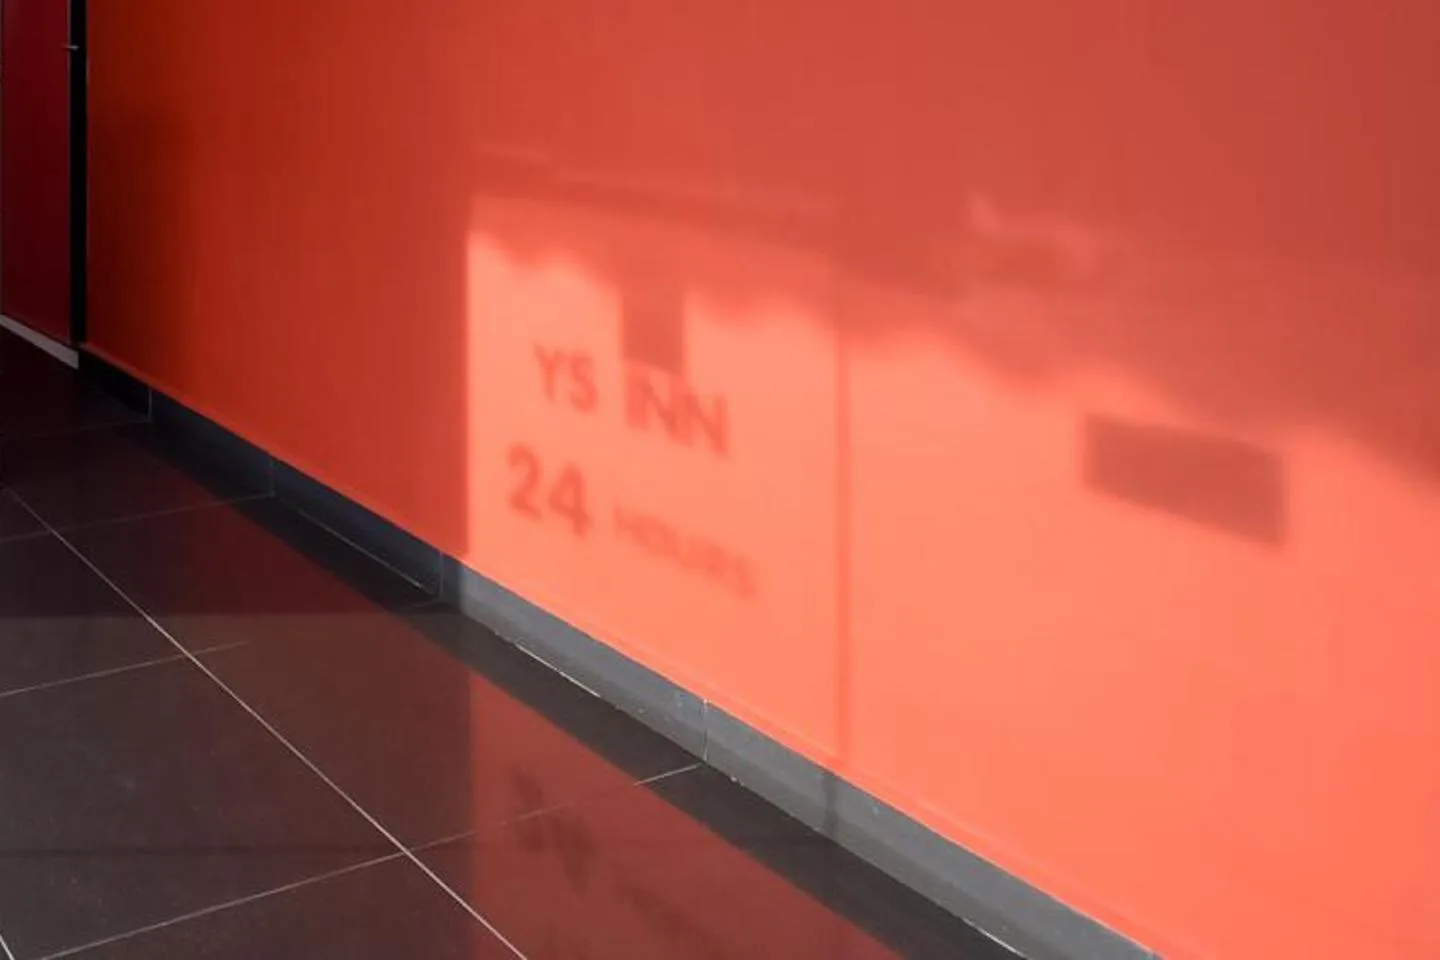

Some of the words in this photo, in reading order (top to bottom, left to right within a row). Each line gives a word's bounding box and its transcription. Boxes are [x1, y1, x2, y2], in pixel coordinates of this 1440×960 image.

[534, 344, 599, 414] YS
[622, 365, 730, 456] INN
[505, 442, 594, 538] 24
[612, 502, 758, 596] HOURS
